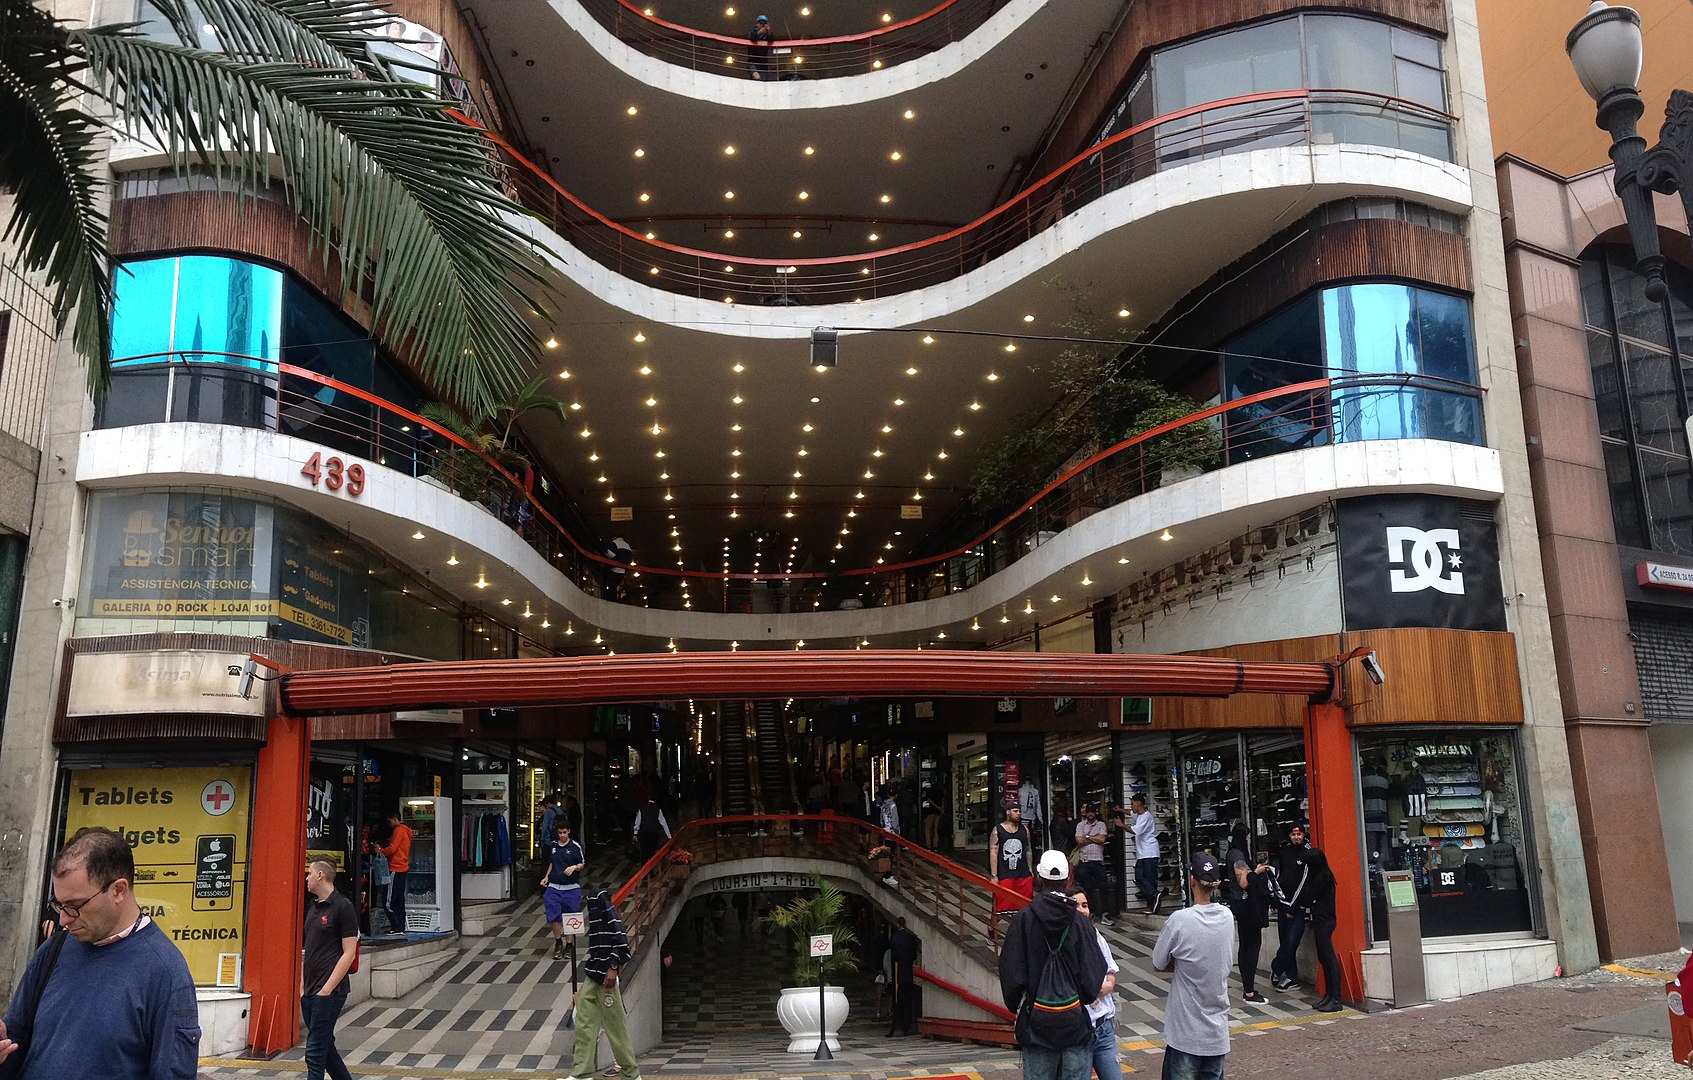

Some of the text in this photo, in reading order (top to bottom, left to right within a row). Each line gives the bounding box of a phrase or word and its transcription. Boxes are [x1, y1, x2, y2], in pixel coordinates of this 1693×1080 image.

[301, 452, 365, 495] 439
[159, 518, 263, 544] Senhor
[157, 545, 256, 567] smart
[1386, 526, 1464, 594] DC
[121, 577, 256, 589] ASSISTÊNCIA TÉCNICA
[304, 565, 334, 588] Tablets
[1660, 570, 1676, 579] ACESSO
[103, 603, 151, 612] GALERIA
[156, 603, 171, 612] DO
[177, 603, 208, 612] ROCK
[221, 603, 249, 612] LOJA
[254, 603, 272, 612] 101
[304, 590, 335, 612] Gadgets
[292, 609, 346, 639] TEL: 3361-7722
[79, 787, 174, 806] Tablets
[78, 826, 181, 849] dgets
[172, 925, 238, 940] TÉCNICA
